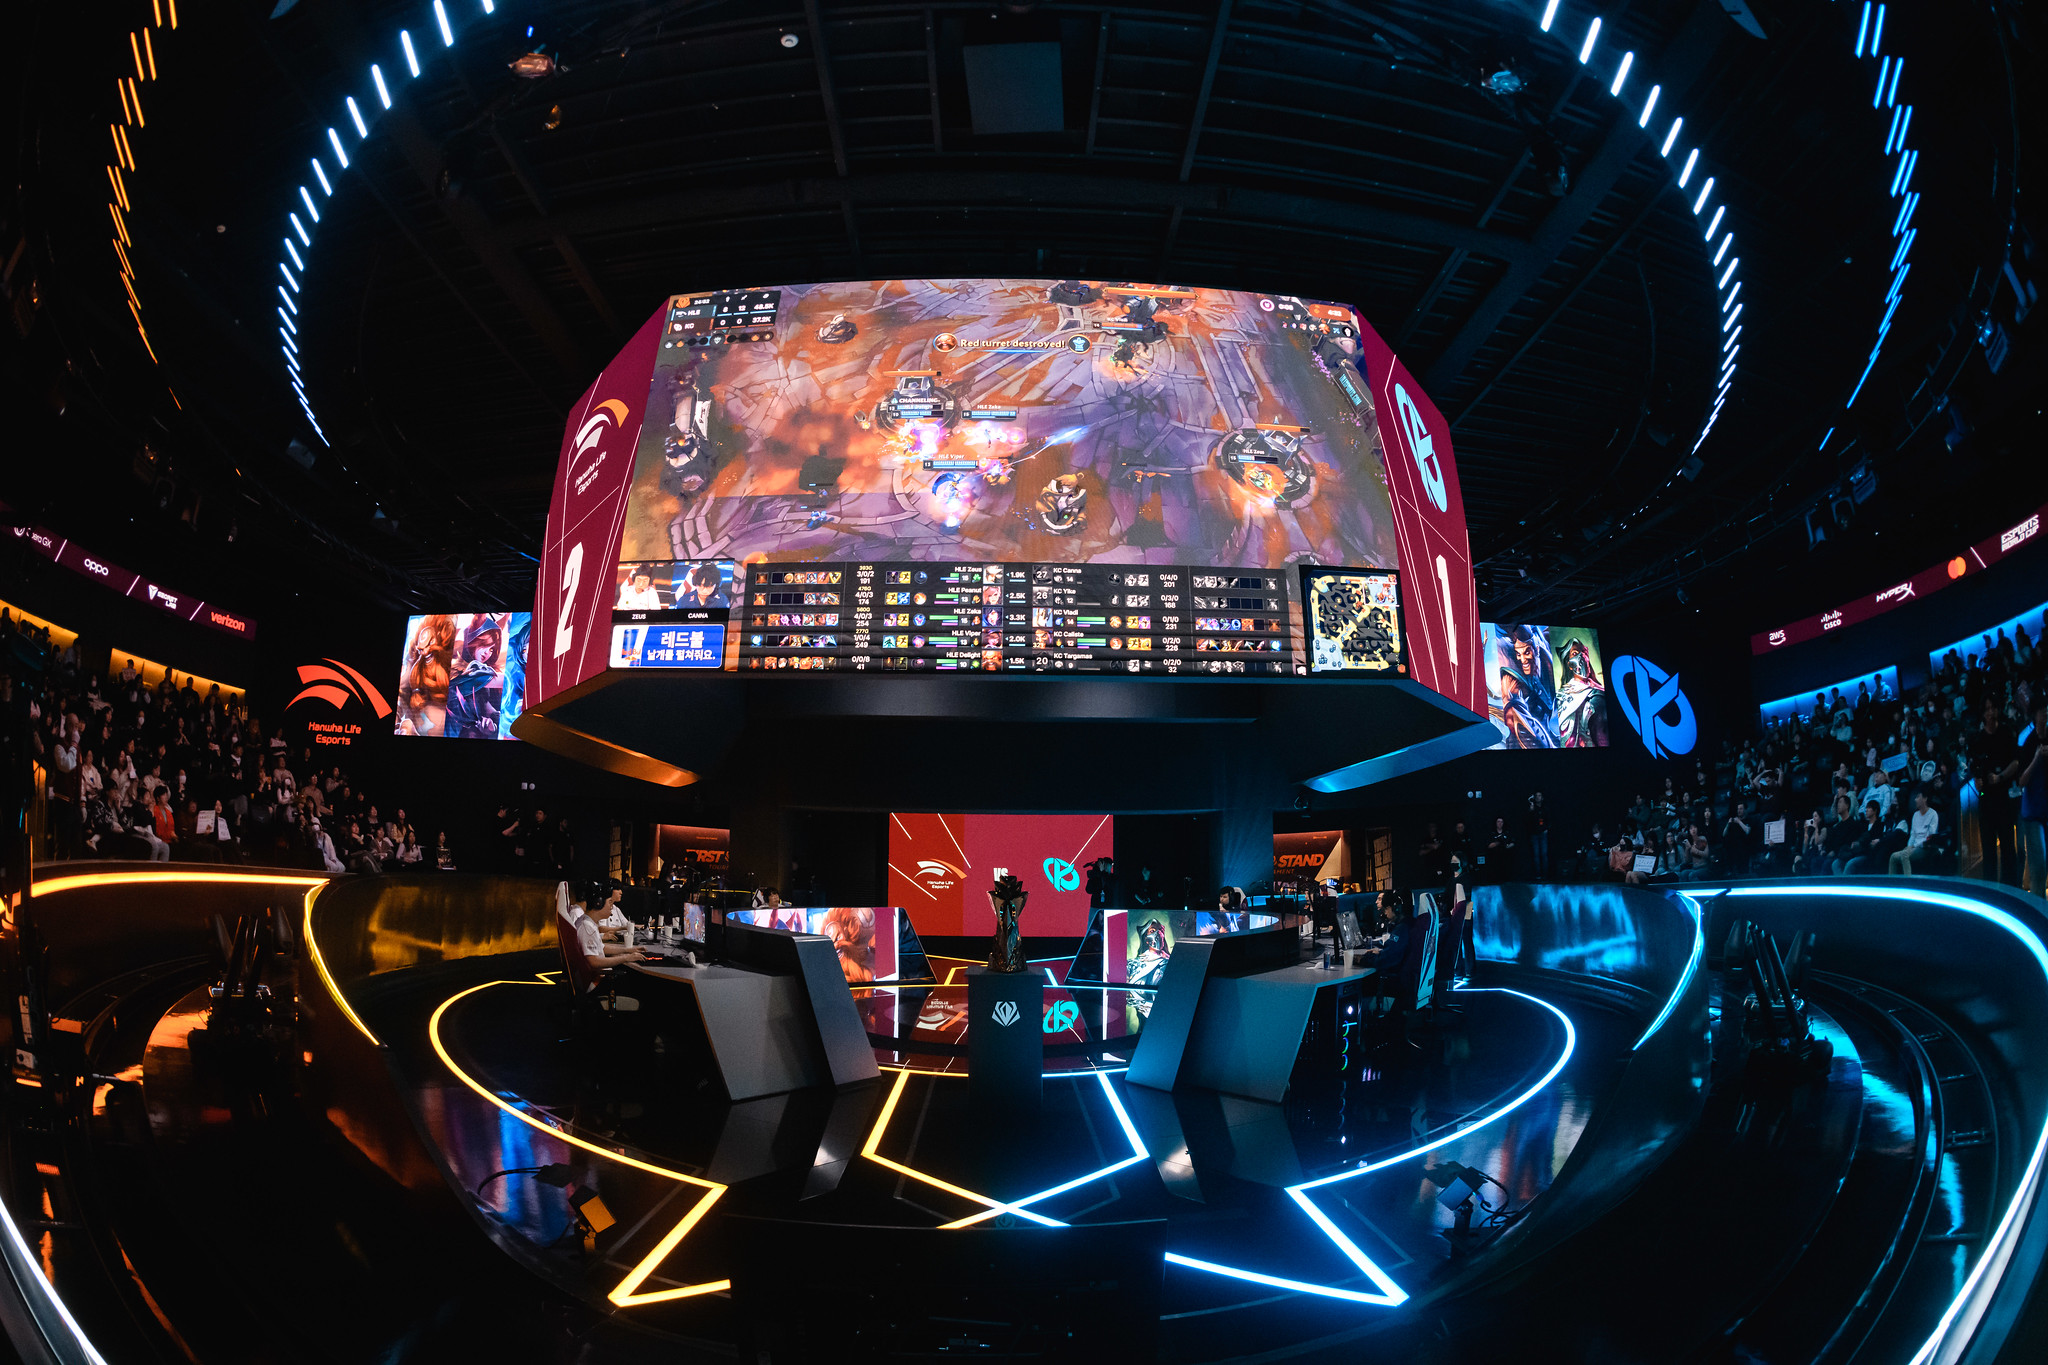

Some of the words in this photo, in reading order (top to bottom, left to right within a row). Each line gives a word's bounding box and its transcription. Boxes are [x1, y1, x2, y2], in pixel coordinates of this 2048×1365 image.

[960, 338, 980, 347] Red
[1012, 339, 1066, 348] destroyed!
[578, 470, 599, 496] Esports
[2001, 514, 2040, 545] ESPORTS
[84, 558, 109, 576] oppo
[554, 542, 584, 659] 2
[1876, 582, 1916, 602] HYPERX
[1436, 554, 1458, 666] 1
[210, 611, 246, 632] verizon
[661, 631, 705, 648] 레드불
[1768, 630, 1786, 641] aws
[647, 649, 674, 661] 날개를
[308, 721, 344, 733] Hanwha
[344, 724, 362, 734] Life
[316, 734, 351, 746] Esports
[1278, 854, 1325, 868] STAND
